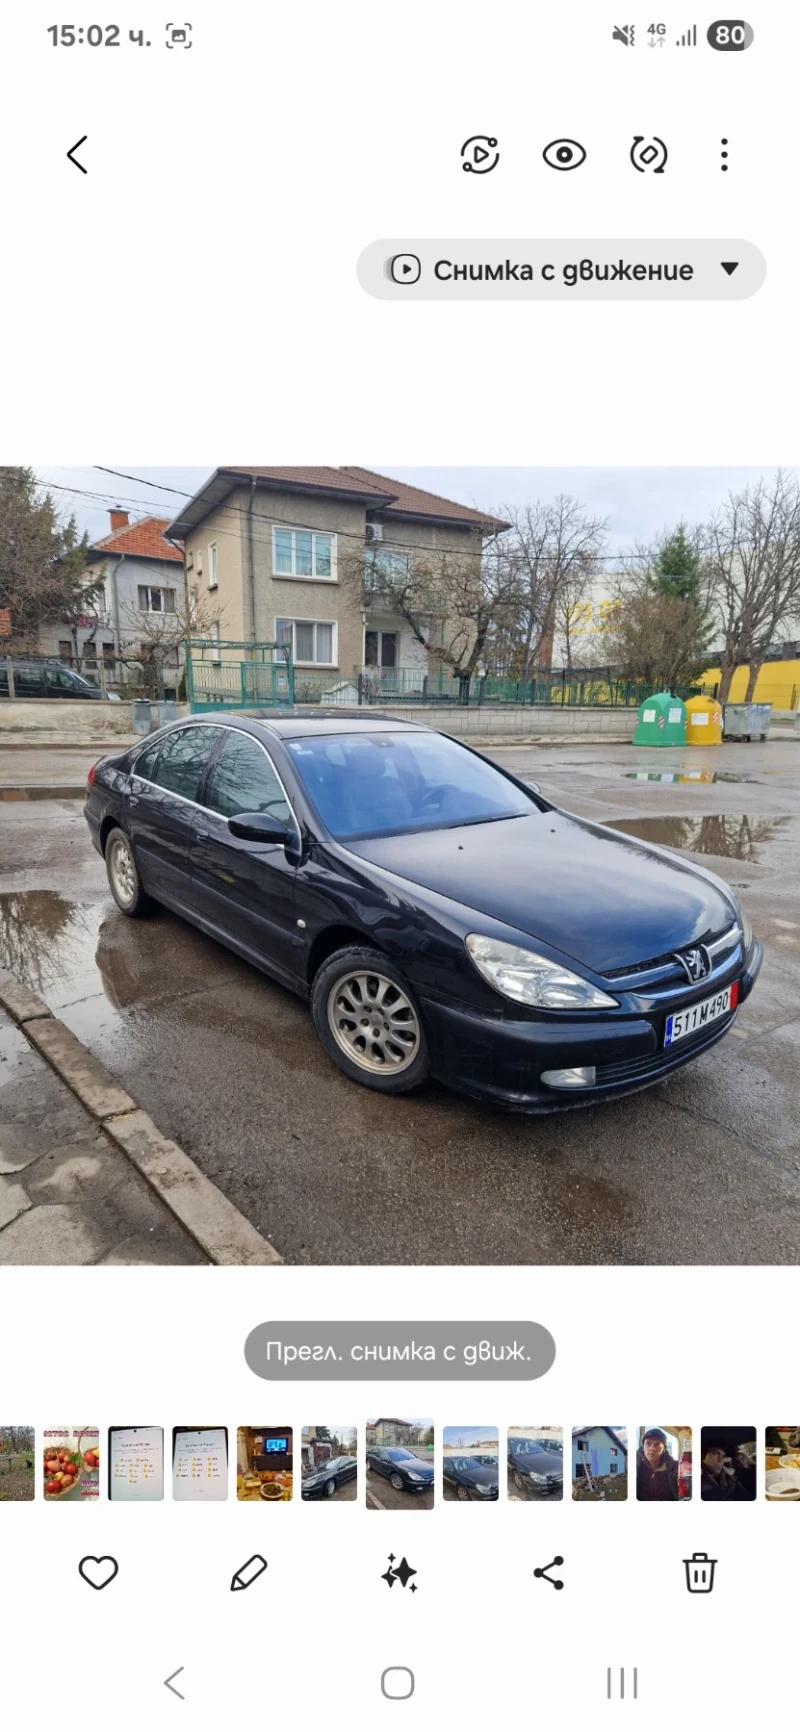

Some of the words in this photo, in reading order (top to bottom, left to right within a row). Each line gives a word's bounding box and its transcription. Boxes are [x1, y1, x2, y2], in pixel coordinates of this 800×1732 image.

[47, 25, 121, 48] 15:02
[128, 29, 152, 48] ч.
[646, 23, 667, 35] 4G
[716, 25, 745, 45] 80
[433, 259, 534, 282] Снимка
[540, 263, 556, 282] с
[562, 258, 694, 287] движение
[673, 991, 730, 1038] 511M490
[266, 1341, 343, 1366] Прегл.
[350, 1340, 436, 1362] снимка
[443, 1345, 456, 1361] с
[463, 1340, 531, 1366] движ.
